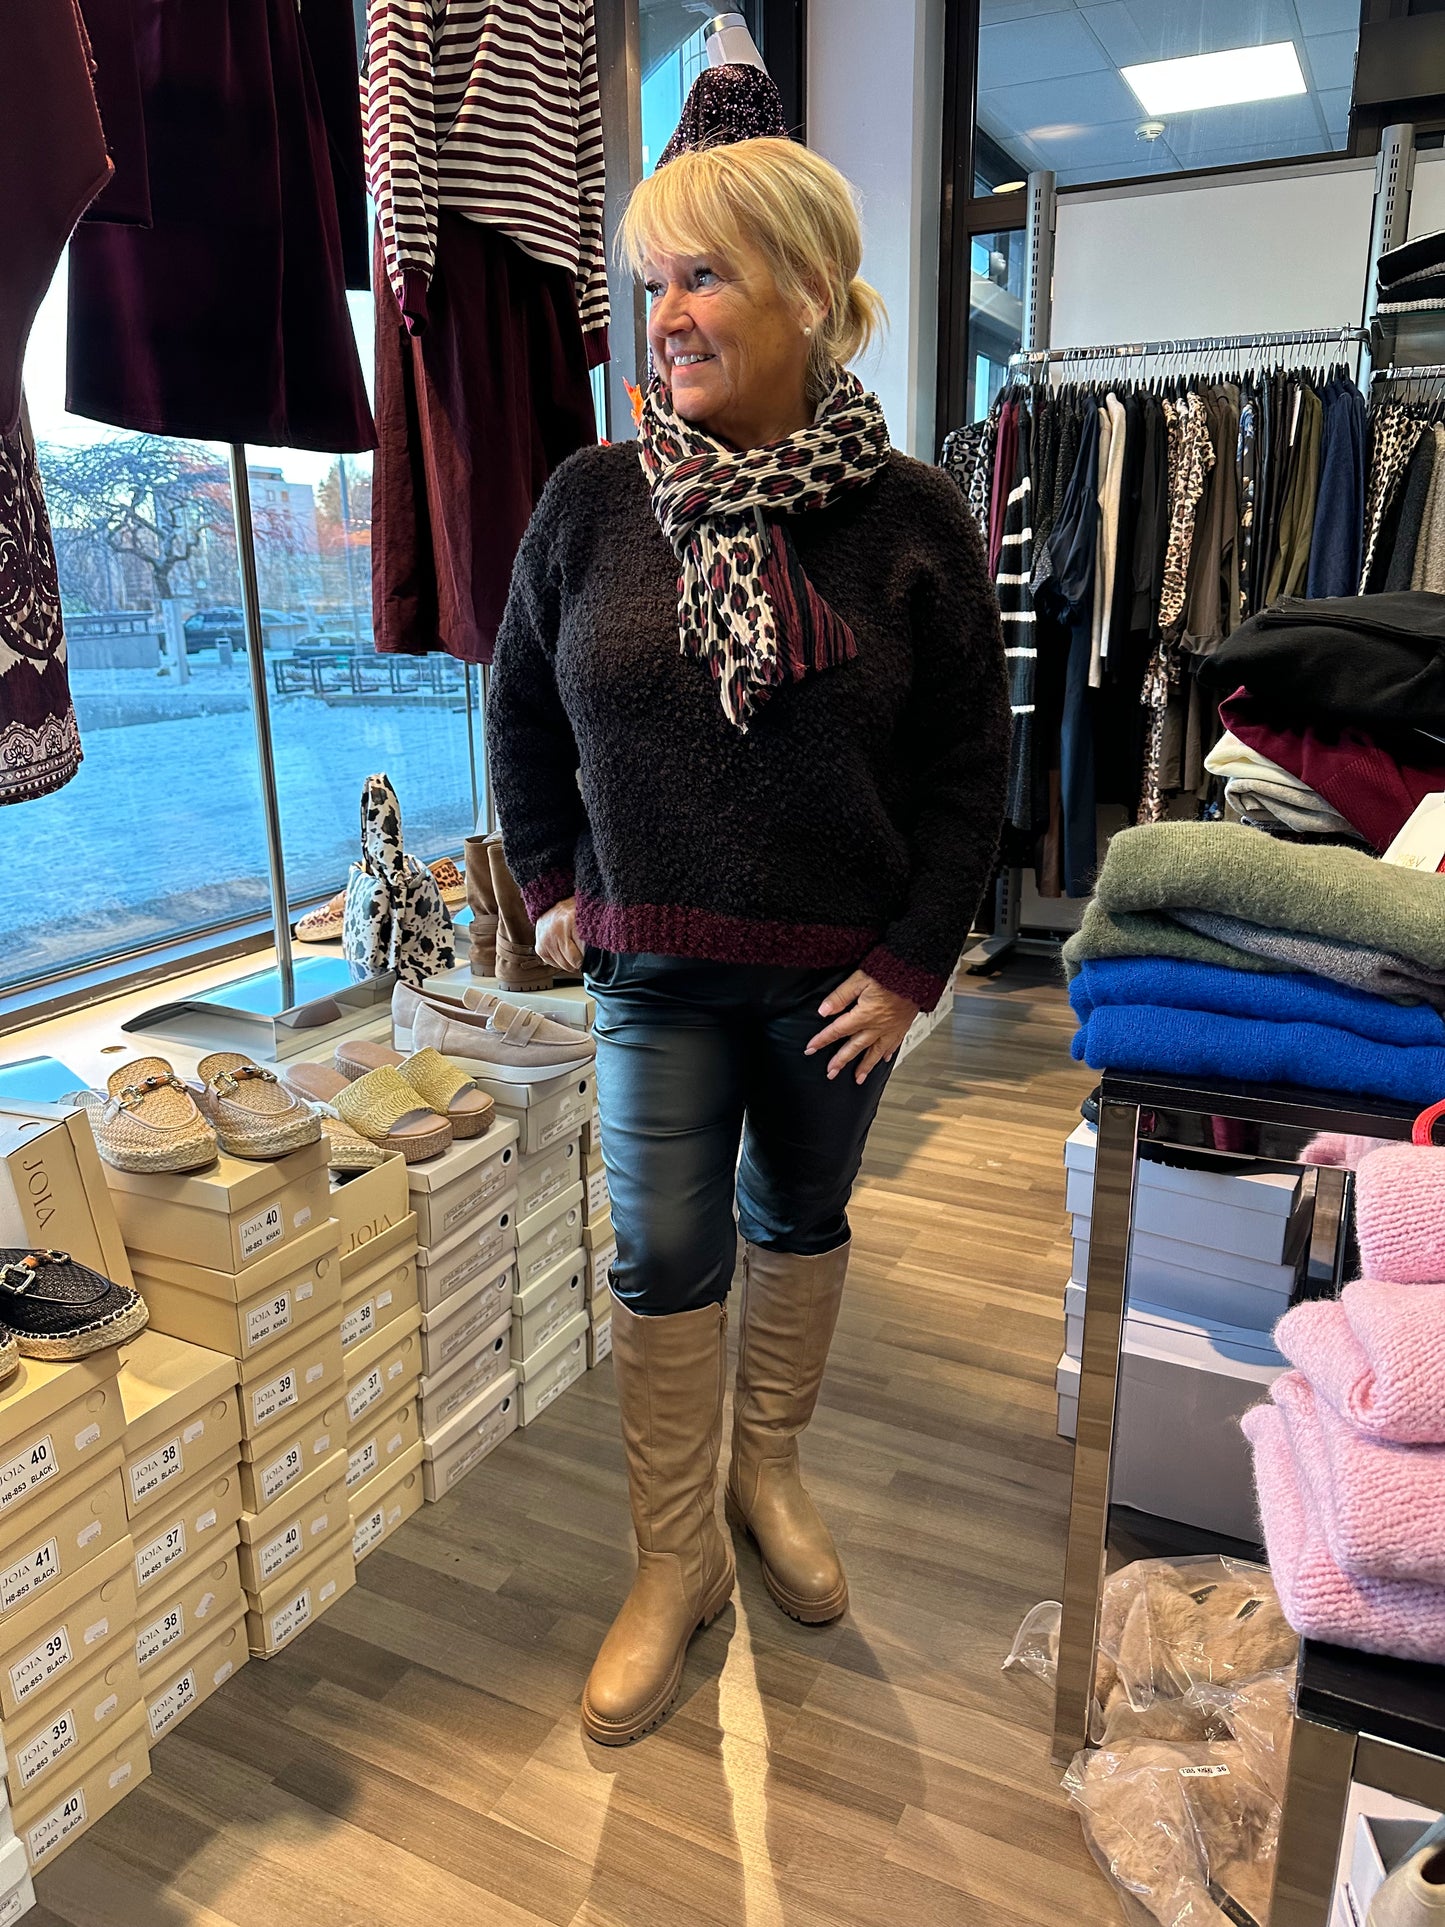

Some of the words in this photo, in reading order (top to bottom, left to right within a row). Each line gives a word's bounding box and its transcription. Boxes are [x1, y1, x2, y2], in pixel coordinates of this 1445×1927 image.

[22, 1159, 56, 1231] JOIA
[244, 1222, 263, 1238] JOIA
[266, 1210, 277, 1226] 40
[348, 1214, 393, 1253] JOIA
[251, 1310, 271, 1325] JOIA
[274, 1299, 286, 1315] 39
[360, 1306, 370, 1320] 38
[257, 1388, 276, 1405] JOIA
[280, 1376, 290, 1392] 39
[368, 1373, 377, 1388] 37
[0, 1464, 25, 1486] JOIA
[31, 1445, 47, 1465] 40
[135, 1460, 158, 1481] JOIA
[163, 1446, 175, 1463] 38
[266, 1466, 283, 1483] JOIA
[286, 1451, 297, 1467] 39
[364, 1446, 372, 1460] 37
[1, 1482, 26, 1503] H8-853
[31, 1464, 53, 1483] BLACK
[138, 1478, 157, 1496] H8-853
[161, 1463, 179, 1479] BLACK
[140, 1545, 163, 1565] JOIA
[167, 1529, 179, 1547] 37
[264, 1543, 282, 1561] JOIA
[286, 1529, 296, 1544] 40
[3, 1566, 30, 1588] JOIA
[36, 1547, 50, 1567] 41
[142, 1562, 161, 1580] H8-853
[165, 1548, 182, 1564] BLACK
[6, 1584, 29, 1605] H8-853
[34, 1566, 55, 1586] BLACK
[296, 1596, 305, 1611] 41
[137, 1629, 160, 1648] JOIA
[164, 1613, 177, 1630] 38
[163, 1629, 180, 1646] BLACK
[16, 1657, 42, 1681] JOIA
[46, 1636, 62, 1657] 39
[19, 1674, 43, 1696] H8-853
[47, 1653, 68, 1674] BLACK
[153, 1696, 174, 1718] JOIA
[177, 1678, 190, 1695] 38
[177, 1694, 194, 1710] BLACK
[22, 1740, 48, 1766] JOIA
[52, 1719, 67, 1740] 39
[26, 1757, 49, 1780] H8-853
[52, 1736, 73, 1757] BLACK
[33, 1818, 58, 1843] JOIA
[63, 1798, 78, 1818] 40
[62, 1814, 82, 1834] BLACK
